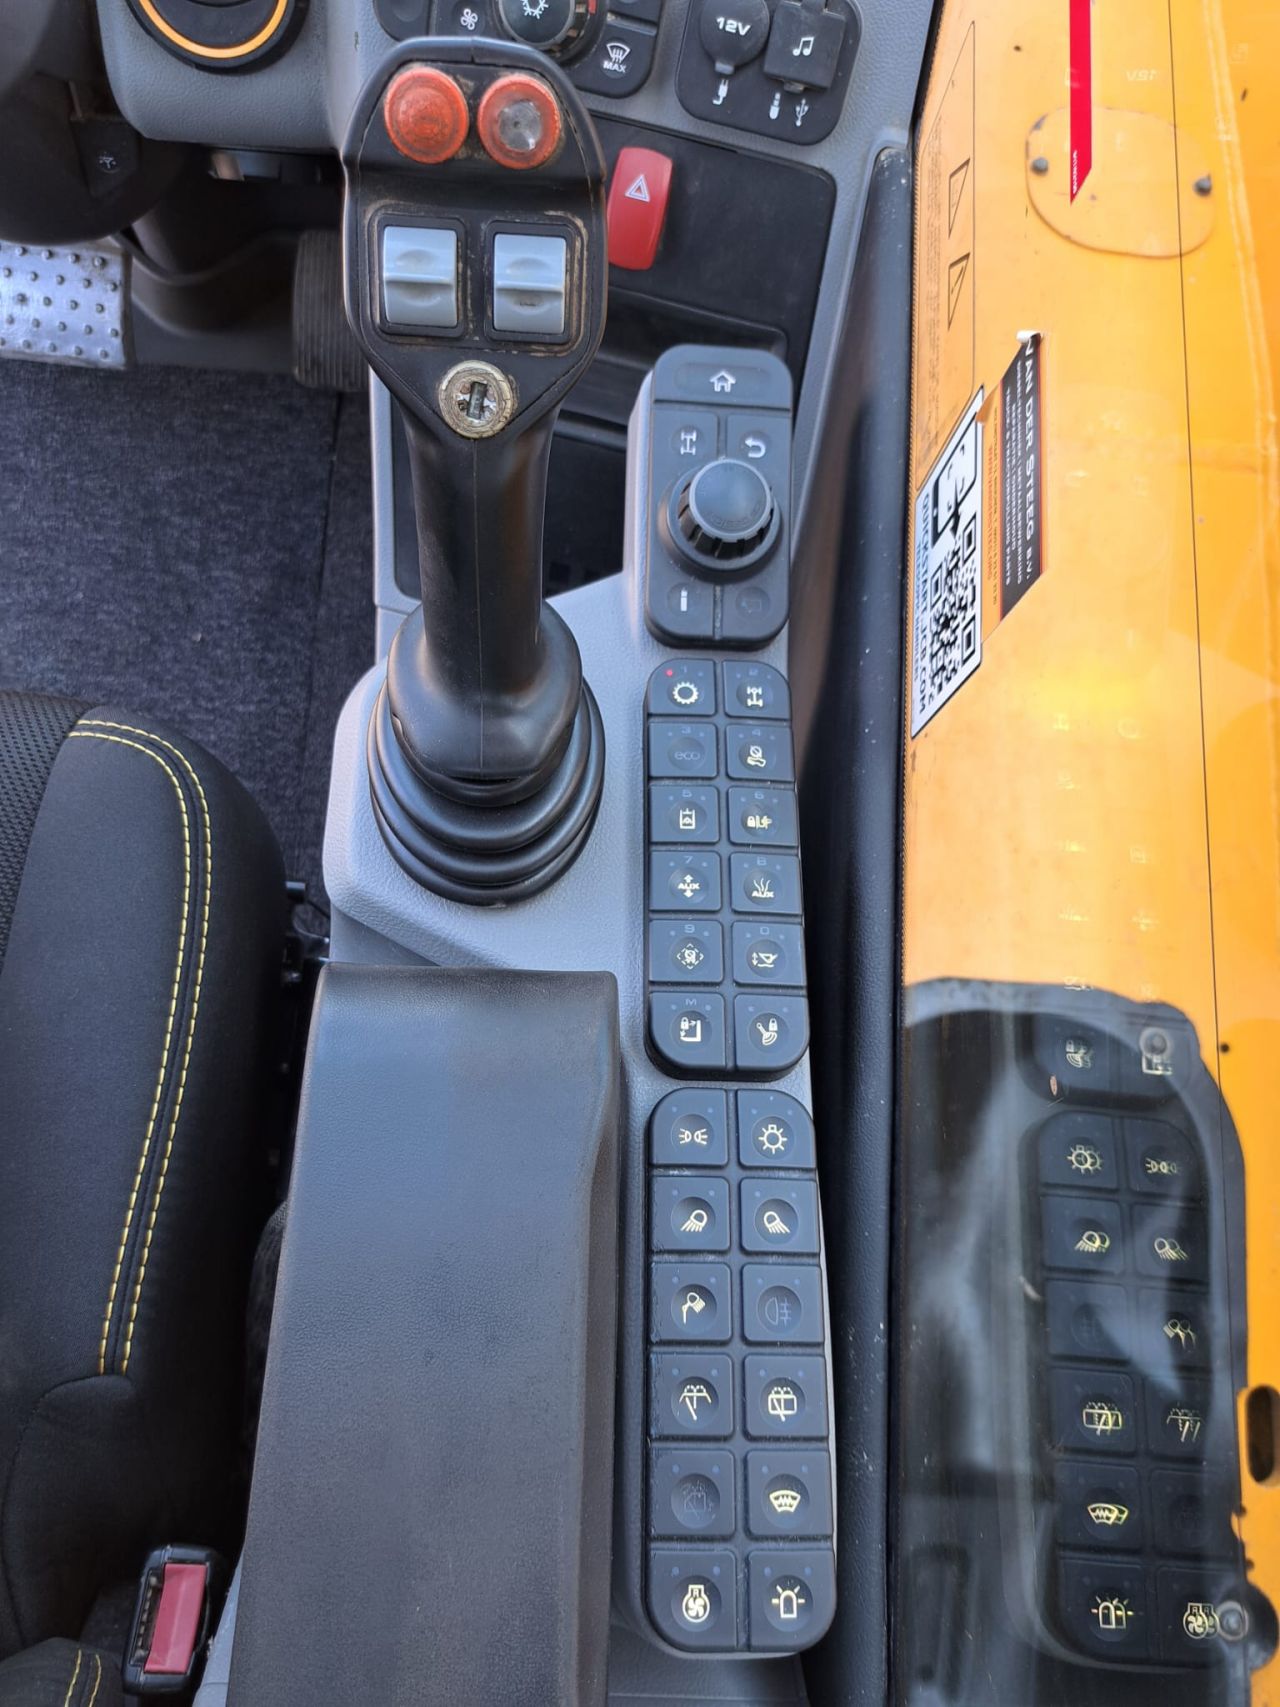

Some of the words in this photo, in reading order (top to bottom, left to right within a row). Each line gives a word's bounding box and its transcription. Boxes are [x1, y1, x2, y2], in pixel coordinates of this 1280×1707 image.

[715, 16, 751, 37] 12V
[602, 60, 627, 74] MAX
[1024, 338, 1035, 396] VAN
[1025, 395, 1035, 452] DER
[1025, 453, 1035, 542] STEEG
[674, 751, 701, 761] eco
[683, 855, 694, 864] 7
[684, 924, 695, 934] 9
